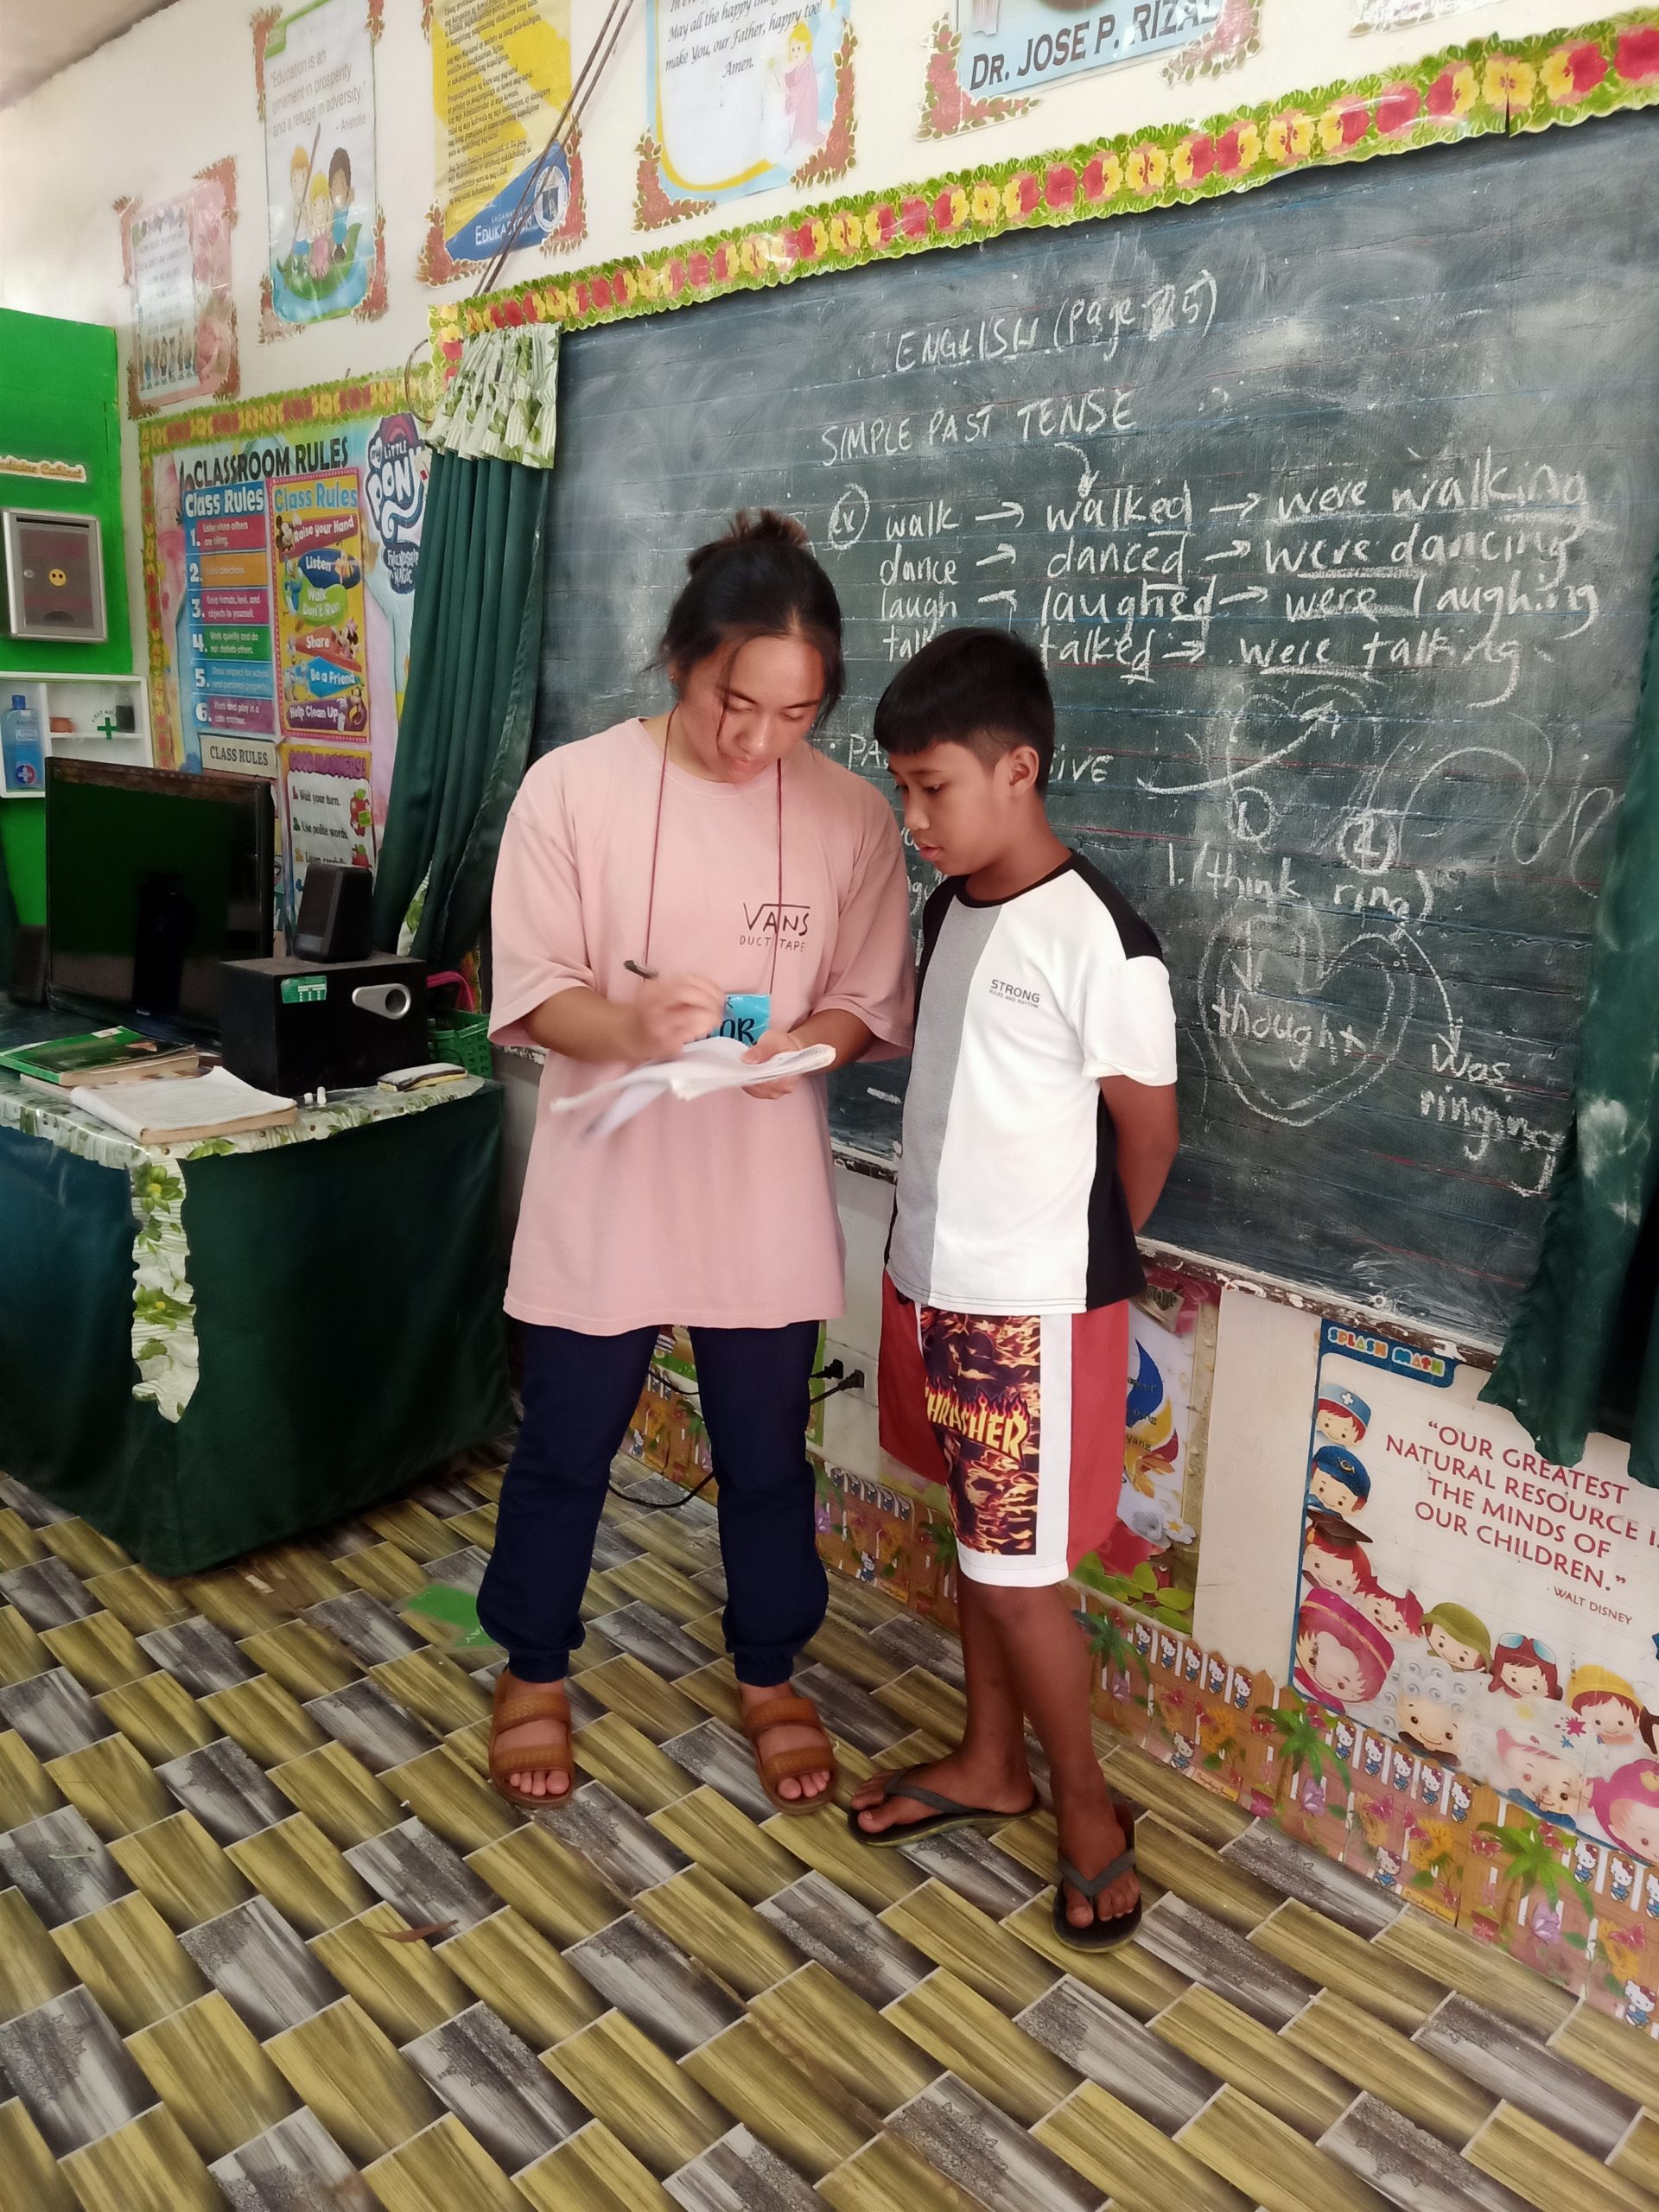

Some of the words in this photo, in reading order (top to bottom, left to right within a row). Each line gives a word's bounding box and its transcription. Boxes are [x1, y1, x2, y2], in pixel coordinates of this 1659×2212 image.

[668, 23, 689, 42] May
[690, 11, 705, 32] all
[704, 8, 720, 27] the
[721, 1, 751, 24] happy
[665, 52, 689, 72] make
[713, 37, 730, 53] our
[730, 22, 766, 50] Father,
[768, 9, 802, 32] happy
[969, 53, 1010, 91] DR.
[1017, 20, 1090, 77] JOSE
[1094, 13, 1120, 54] P.
[308, 53, 315, 69] is
[316, 49, 327, 67] an
[722, 56, 754, 79] Amen.
[272, 86, 304, 114] ornament
[305, 82, 312, 96] in
[315, 63, 352, 95] prosperity
[272, 120, 286, 137] and
[293, 106, 316, 127] refuge
[895, 317, 1039, 372] ENGLISH
[821, 417, 912, 467] SIMPLE
[929, 404, 995, 446] PAST
[1016, 385, 1137, 442] TENSE
[194, 447, 290, 488] CLASSROOM
[295, 435, 349, 474] RULES
[185, 489, 220, 518] Class
[225, 486, 264, 513] Rules
[274, 486, 312, 512] Class
[316, 482, 358, 508] Rules
[885, 498, 960, 542] walk
[1047, 479, 1193, 533] walked
[1278, 478, 1368, 518] were
[1392, 445, 1592, 523] walking
[190, 528, 200, 547] 1.
[293, 525, 313, 543] Raise
[315, 522, 332, 537] your
[334, 514, 354, 534] Hand
[189, 563, 203, 582] 2.
[305, 556, 332, 572] Listen
[880, 543, 959, 587] dance
[1047, 535, 1189, 587] danced
[1265, 537, 1371, 574] were
[1390, 523, 1581, 592] dancing
[191, 599, 205, 618] 3.
[302, 603, 324, 618] Don't
[325, 602, 340, 615] Run
[308, 588, 327, 602] Walk
[880, 588, 958, 641] laugh
[1040, 574, 1217, 644] laughed
[1287, 587, 1378, 622] were
[1414, 570, 1599, 640] laughing
[193, 634, 207, 652] 4.
[306, 635, 330, 649] Share
[195, 668, 209, 688] 5.
[311, 668, 321, 682] Be
[321, 672, 327, 683] a
[328, 671, 355, 685] Friend
[1039, 622, 1156, 678] talked
[1240, 635, 1331, 668] were
[1363, 626, 1521, 709] talking
[195, 702, 212, 722] 6.
[289, 705, 304, 721] Help
[306, 705, 326, 719] Clean
[327, 706, 339, 722] Up
[210, 746, 238, 762] CLASS
[239, 749, 269, 766] RULES
[299, 790, 312, 802] Wait
[312, 794, 325, 805] your
[326, 795, 341, 806] turn.
[302, 822, 313, 833] Use
[313, 823, 329, 836] polite
[743, 903, 810, 937] VANS
[740, 935, 772, 947] DUCT
[779, 938, 806, 952] TAPE
[990, 978, 1041, 1003] STRONG
[1327, 1326, 1389, 1359] SPLASH
[1392, 1346, 1446, 1377] MATH
[1386, 1434, 1497, 1490] NATURAL
[1504, 1478, 1639, 1541] RESOURCE
[1503, 1447, 1630, 1505] GREATEST
[1415, 1502, 1469, 1536] OUR
[1427, 1477, 1474, 1510] THE
[1482, 1497, 1565, 1543] MINDS
[1573, 1533, 1611, 1559] OF
[1553, 1586, 1586, 1606] WALT
[1589, 1599, 1633, 1625] DISNEY
